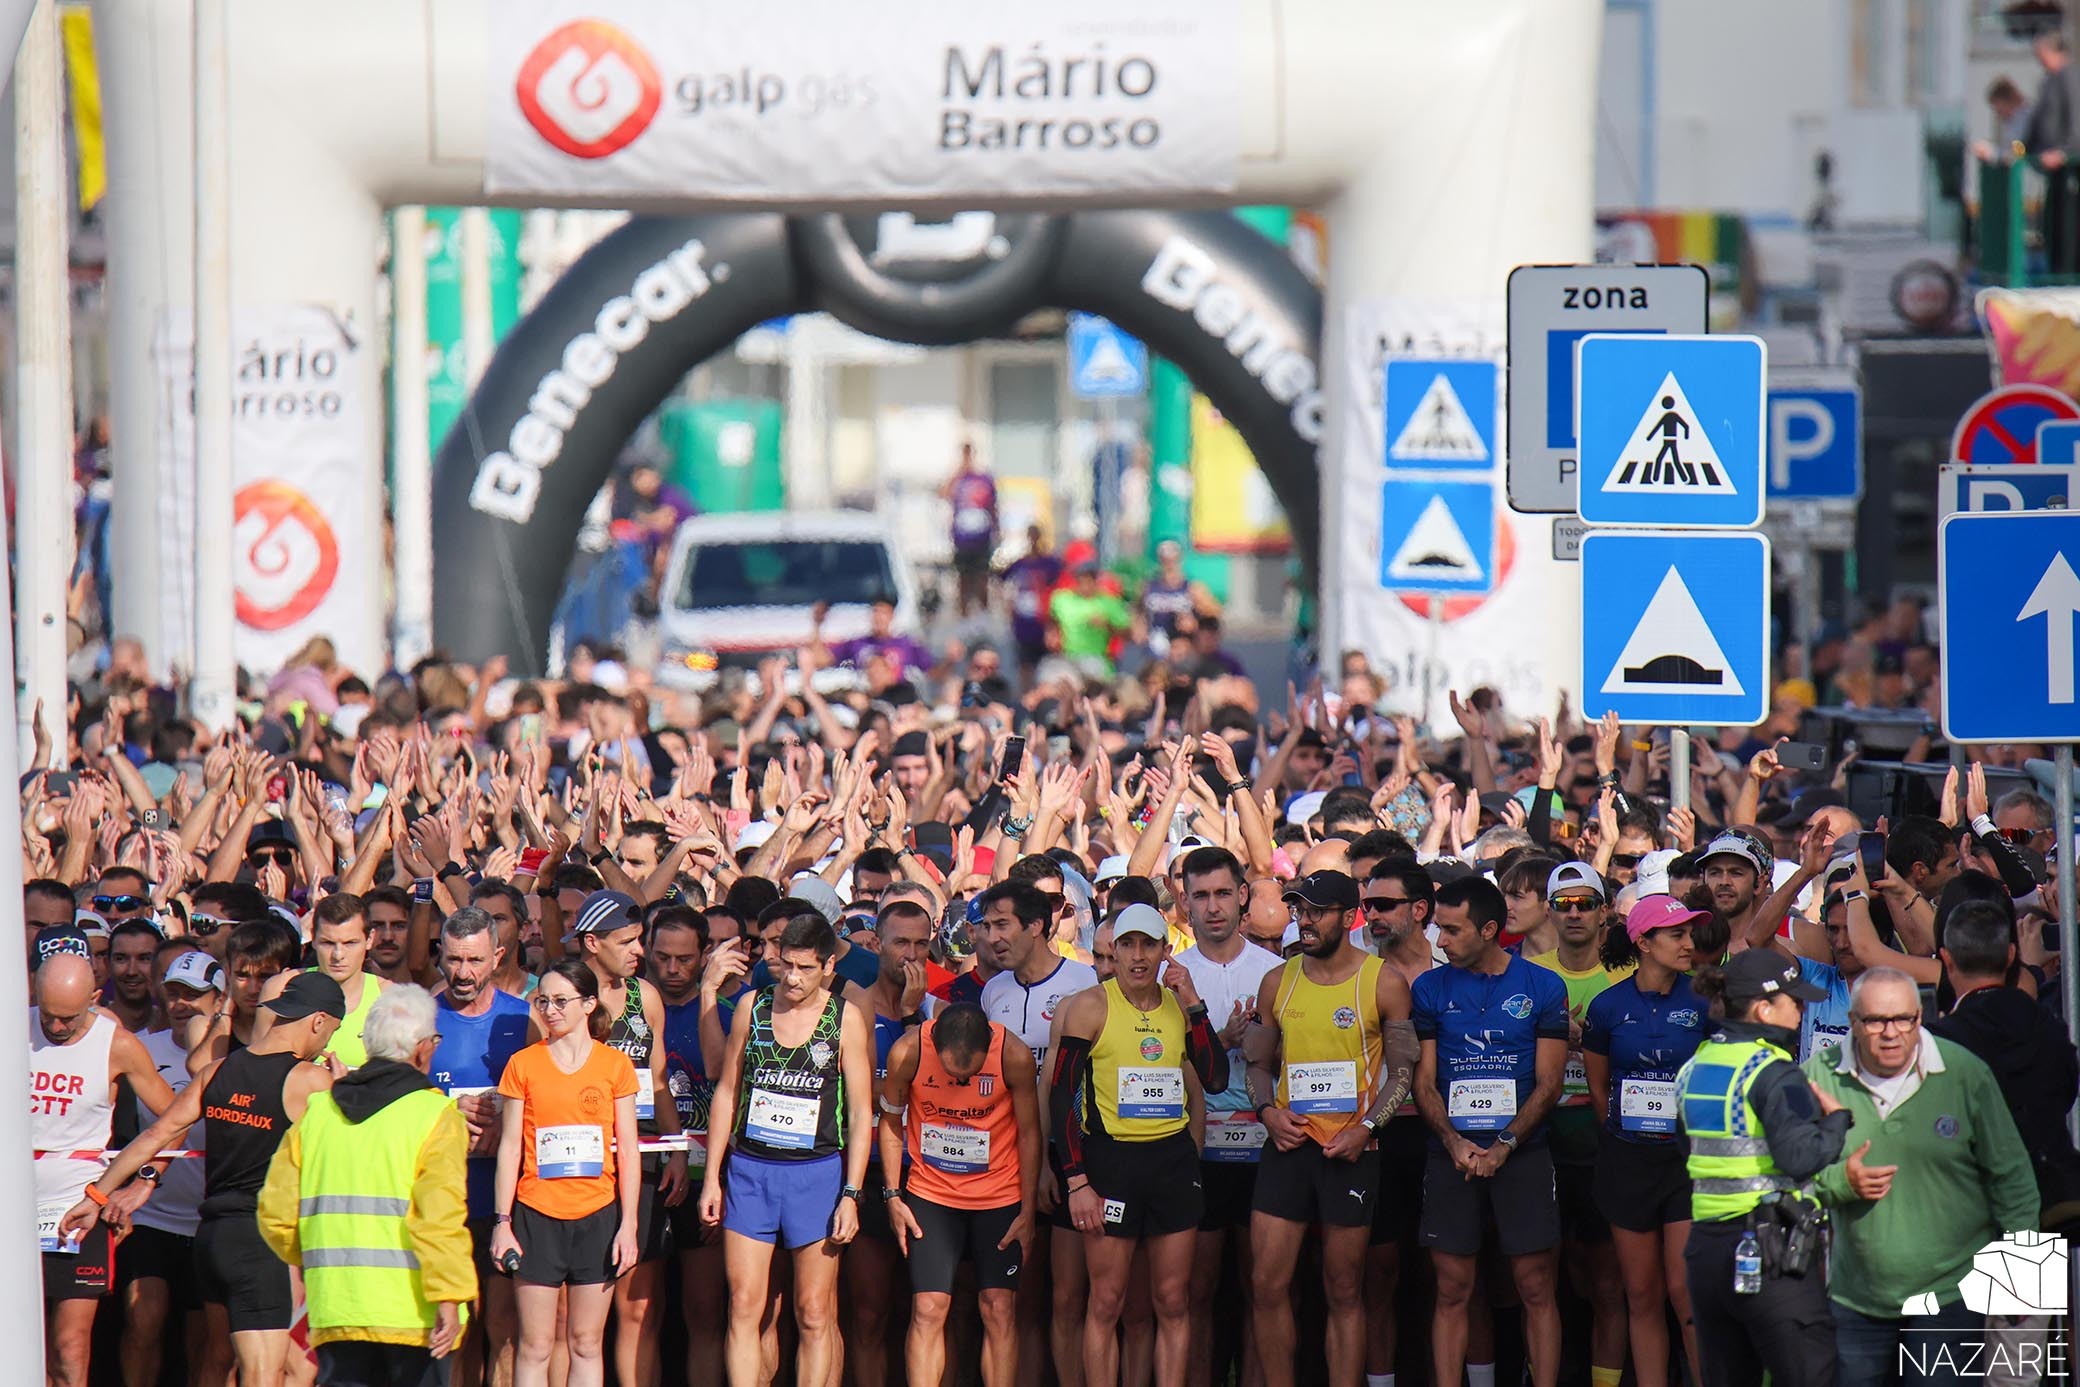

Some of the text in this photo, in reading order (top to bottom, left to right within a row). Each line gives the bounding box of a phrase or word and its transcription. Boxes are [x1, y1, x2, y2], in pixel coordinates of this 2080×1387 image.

[944, 40, 1157, 98] Mário
[675, 67, 785, 115] galp
[941, 110, 1160, 150] Barroso
[1563, 287, 1649, 310] zona
[237, 337, 339, 380] ário
[1770, 398, 1836, 491] P
[1449, 1054, 1518, 1064] SUBLIME
[1453, 1063, 1513, 1072] ESQUADRIA
[30, 1071, 84, 1096] DCR
[753, 1067, 824, 1089] Gislotica
[1142, 1088, 1164, 1097] 955
[1310, 1083, 1332, 1093] 997
[1470, 1099, 1492, 1109] 429
[1647, 1101, 1663, 1111] 99
[206, 1106, 273, 1130] BORDEAUX
[770, 1114, 794, 1126] 470
[1224, 1132, 1247, 1142] 707
[565, 1146, 576, 1156] 11
[942, 1145, 965, 1157] 884
[1105, 1204, 1122, 1218] CS
